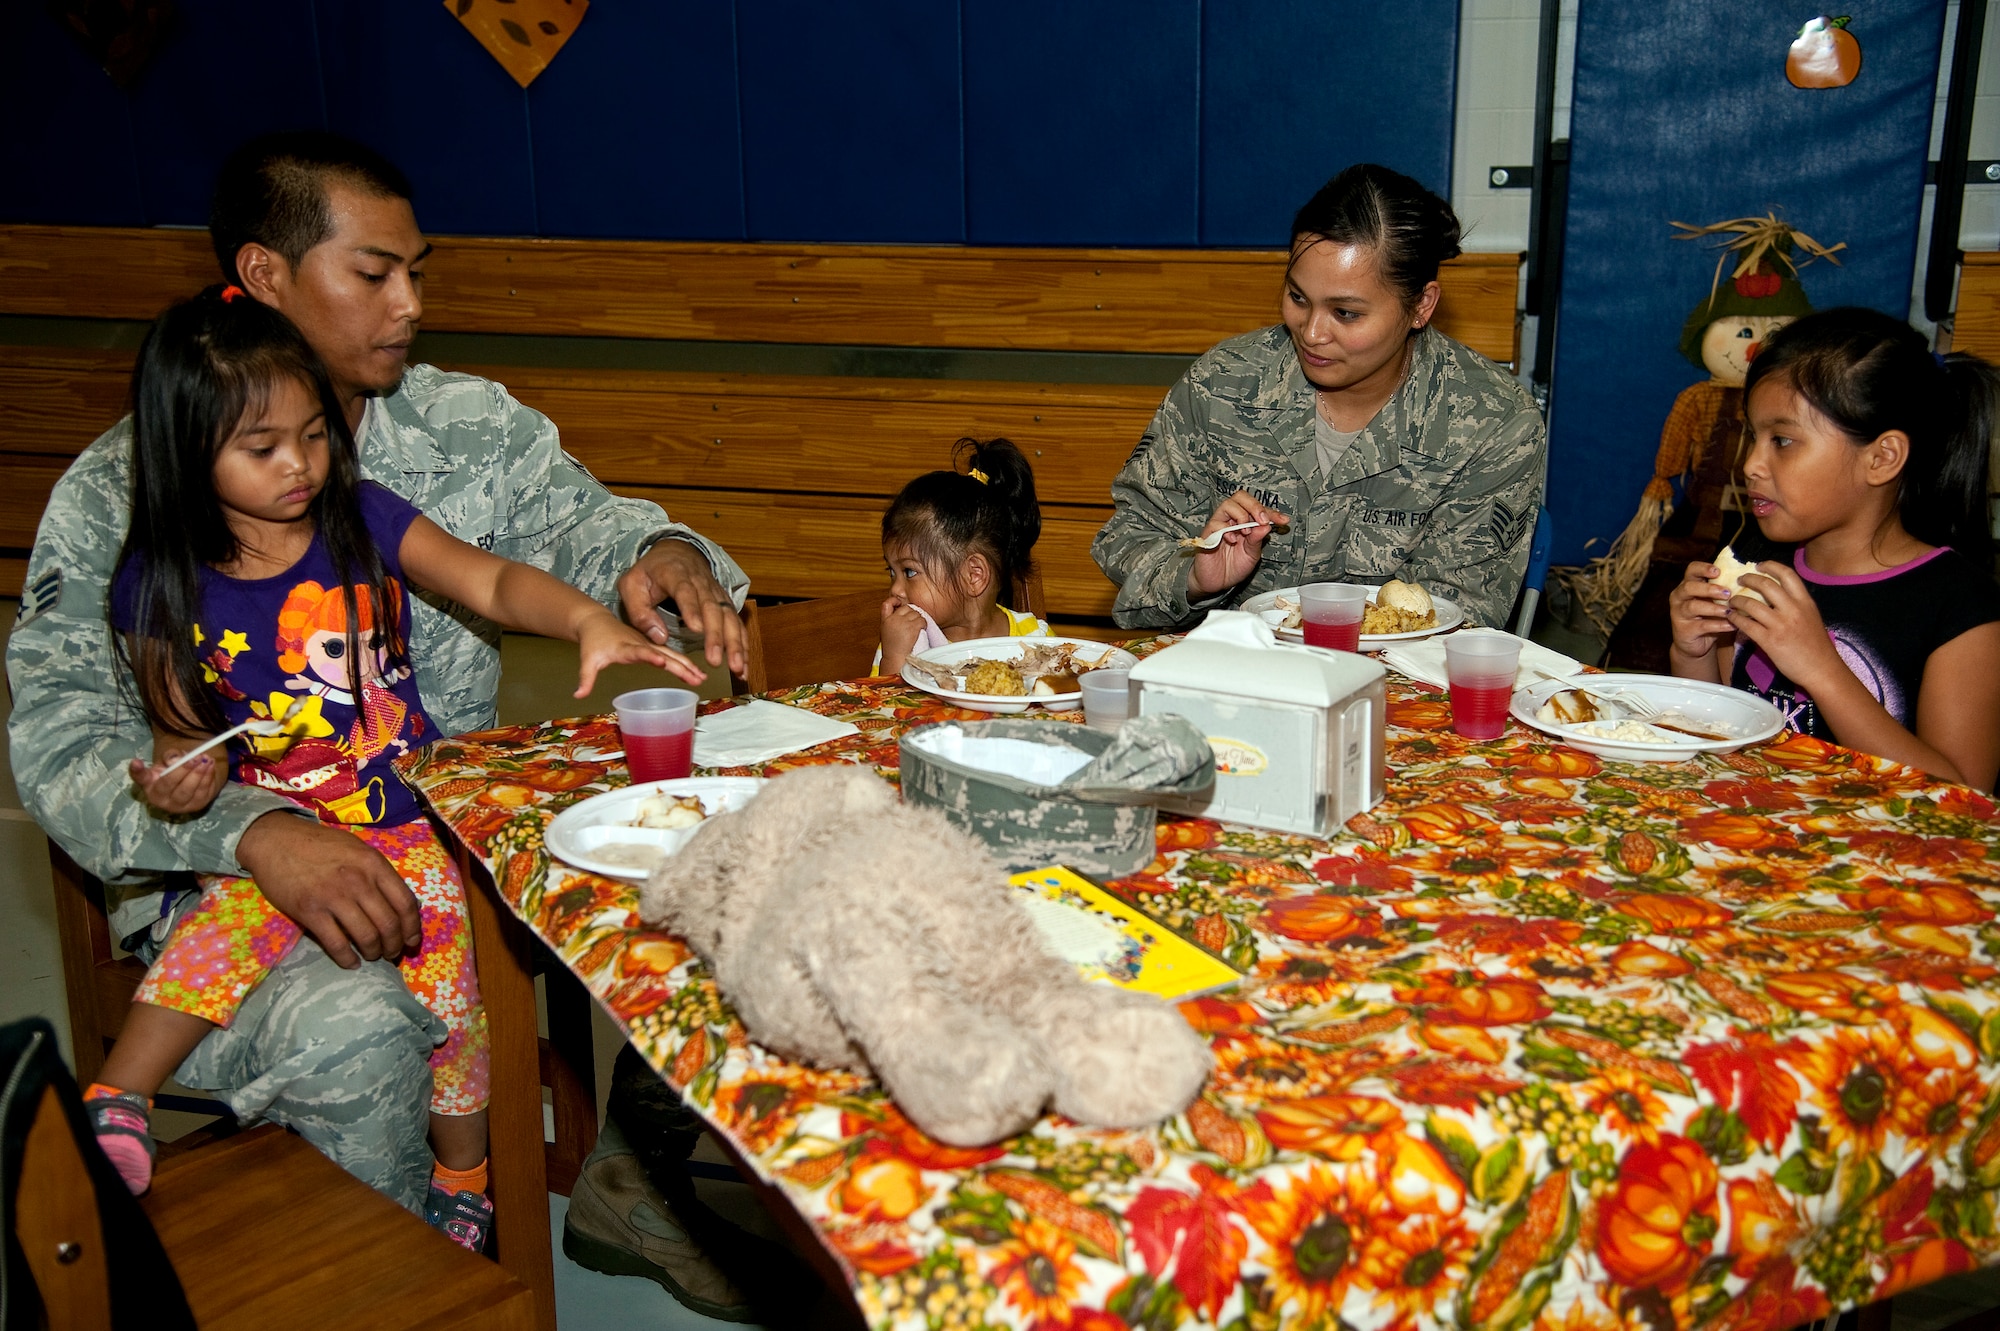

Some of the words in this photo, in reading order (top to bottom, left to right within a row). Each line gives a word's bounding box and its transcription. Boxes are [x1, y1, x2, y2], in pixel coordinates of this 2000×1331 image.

[1216, 478, 1279, 508] ESCONA
[1362, 509, 1380, 524] U.S.
[1385, 511, 1406, 527] AIR
